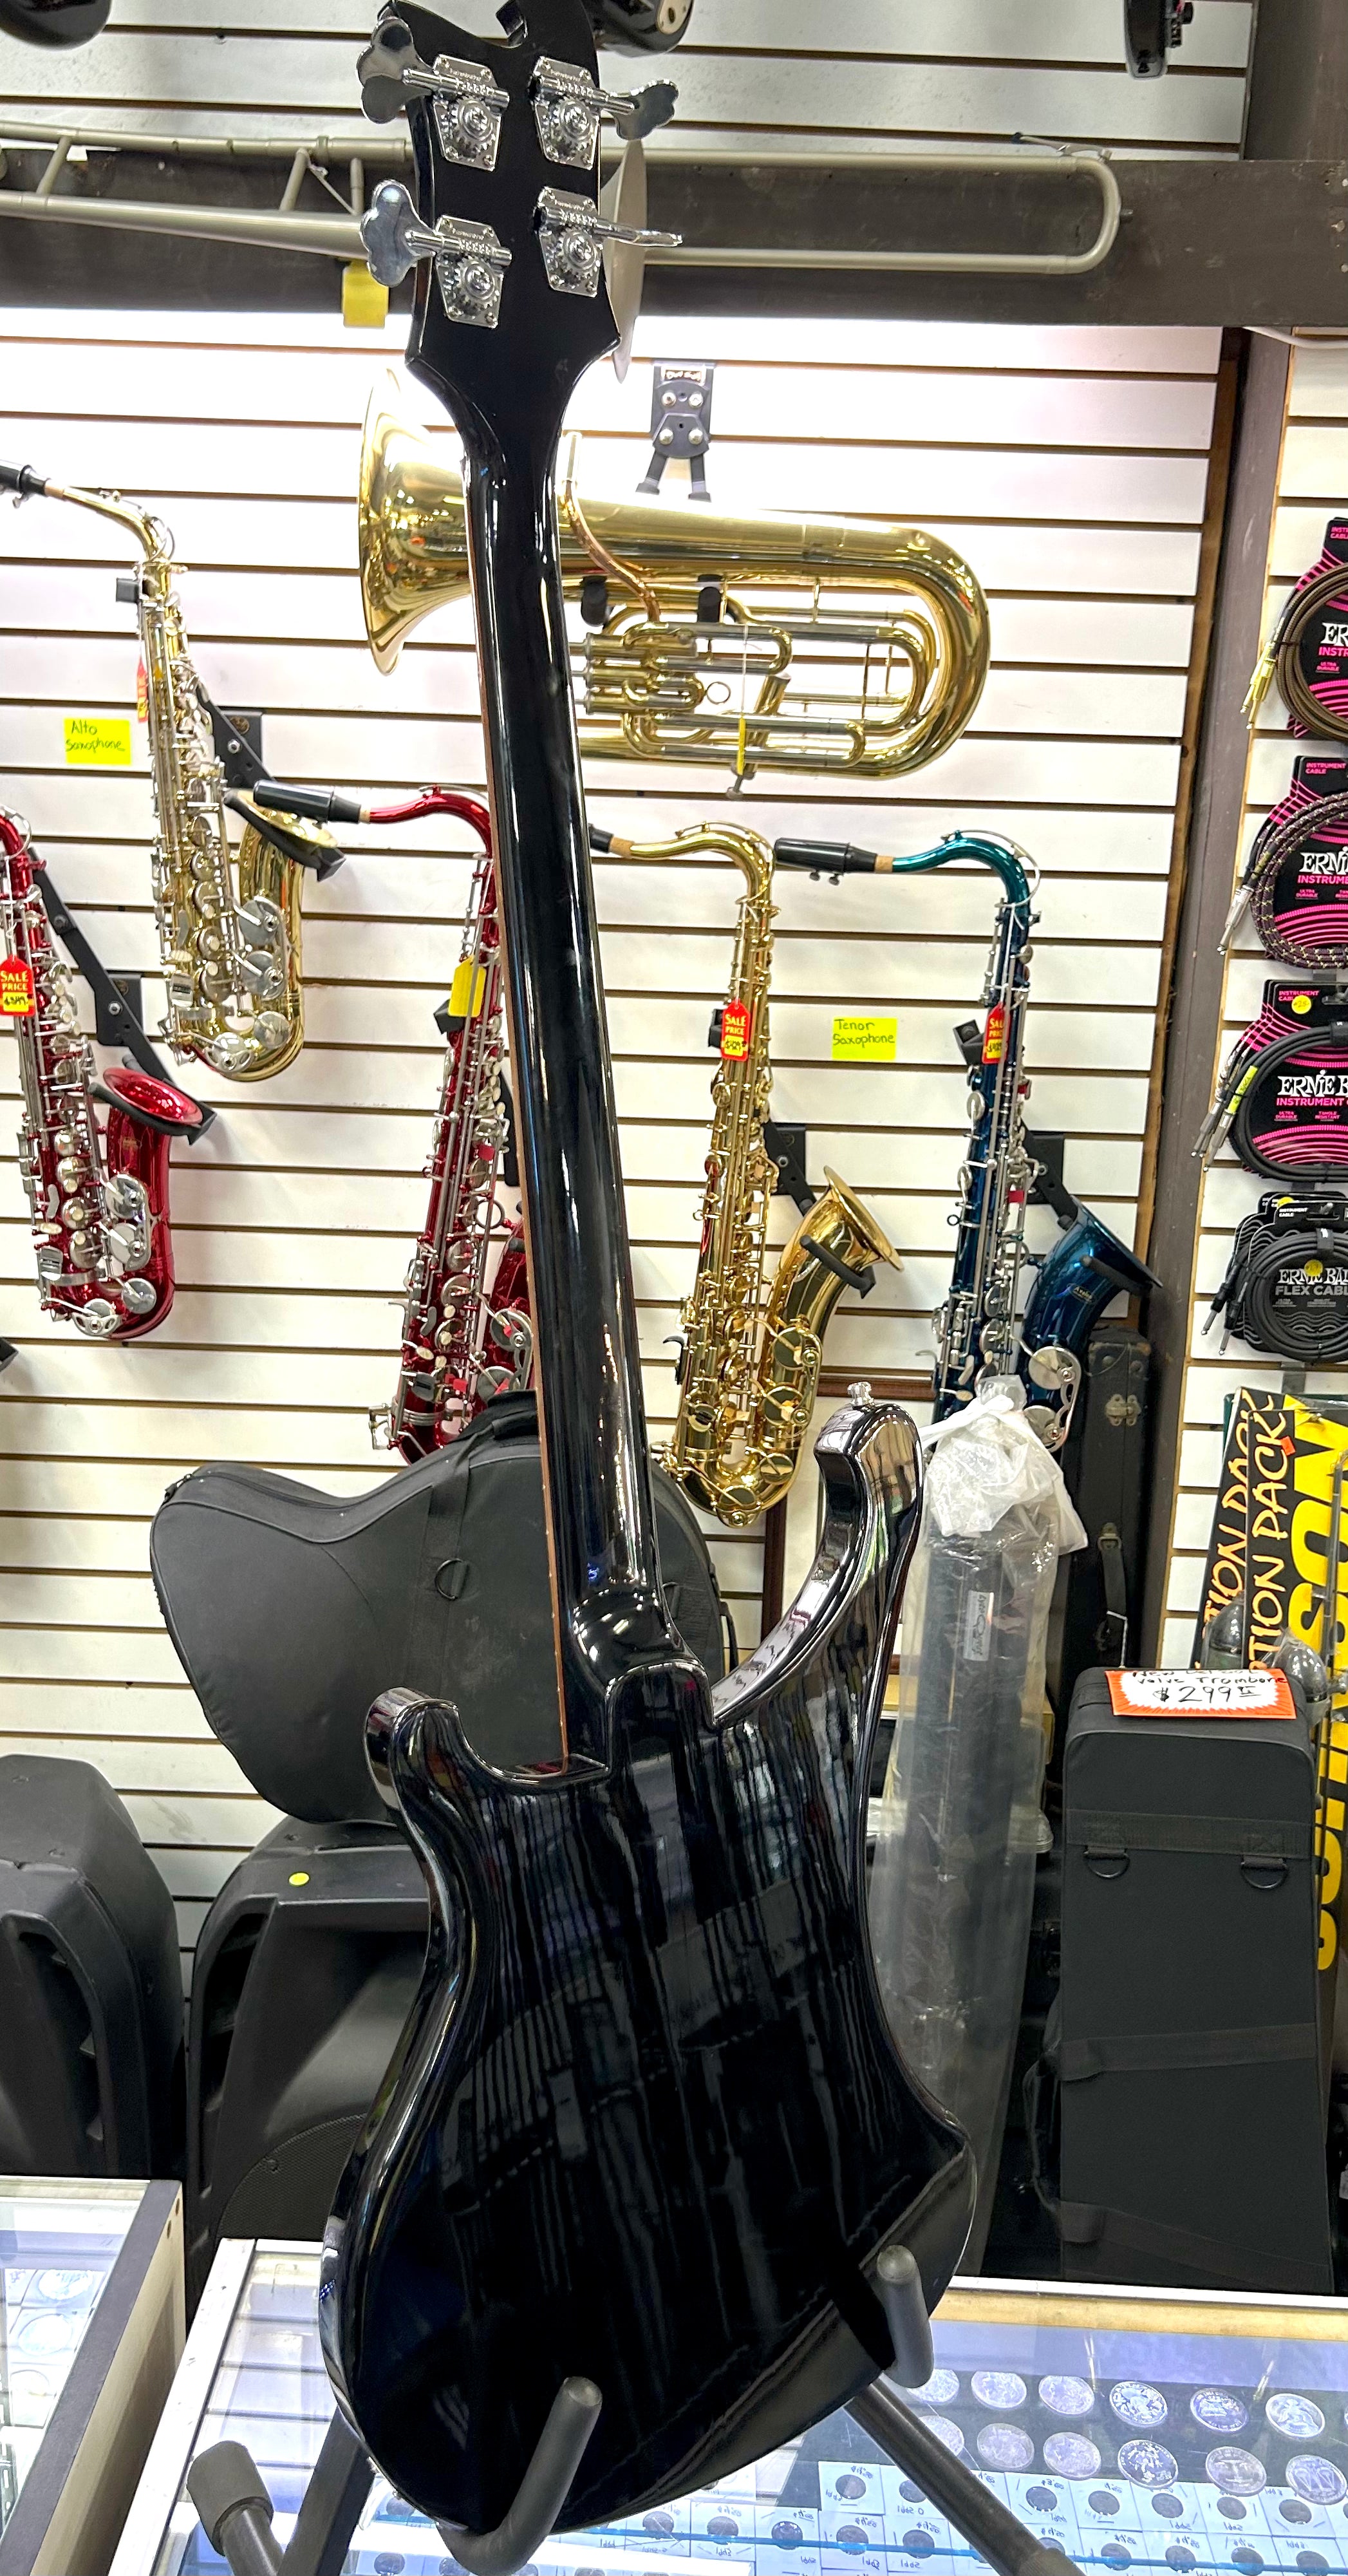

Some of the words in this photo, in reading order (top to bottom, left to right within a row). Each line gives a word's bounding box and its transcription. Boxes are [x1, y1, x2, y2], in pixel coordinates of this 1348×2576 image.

[71, 720, 98, 736] Alto
[1, 970, 28, 982] SALE
[3, 982, 28, 992] PRICE
[725, 1013, 747, 1027] SALE
[834, 1019, 875, 1031] Tenor
[989, 1018, 1004, 1029] SAL
[725, 1026, 745, 1035] PRICE
[833, 1033, 895, 1049] Saxophone
[1277, 1069, 1336, 1098] ERNIE
[1276, 1097, 1345, 1106] INSTRUMENT
[1275, 1285, 1310, 1296] FLEX
[1251, 1411, 1289, 1541] PACK
[1196, 1676, 1288, 1684] Trombone
